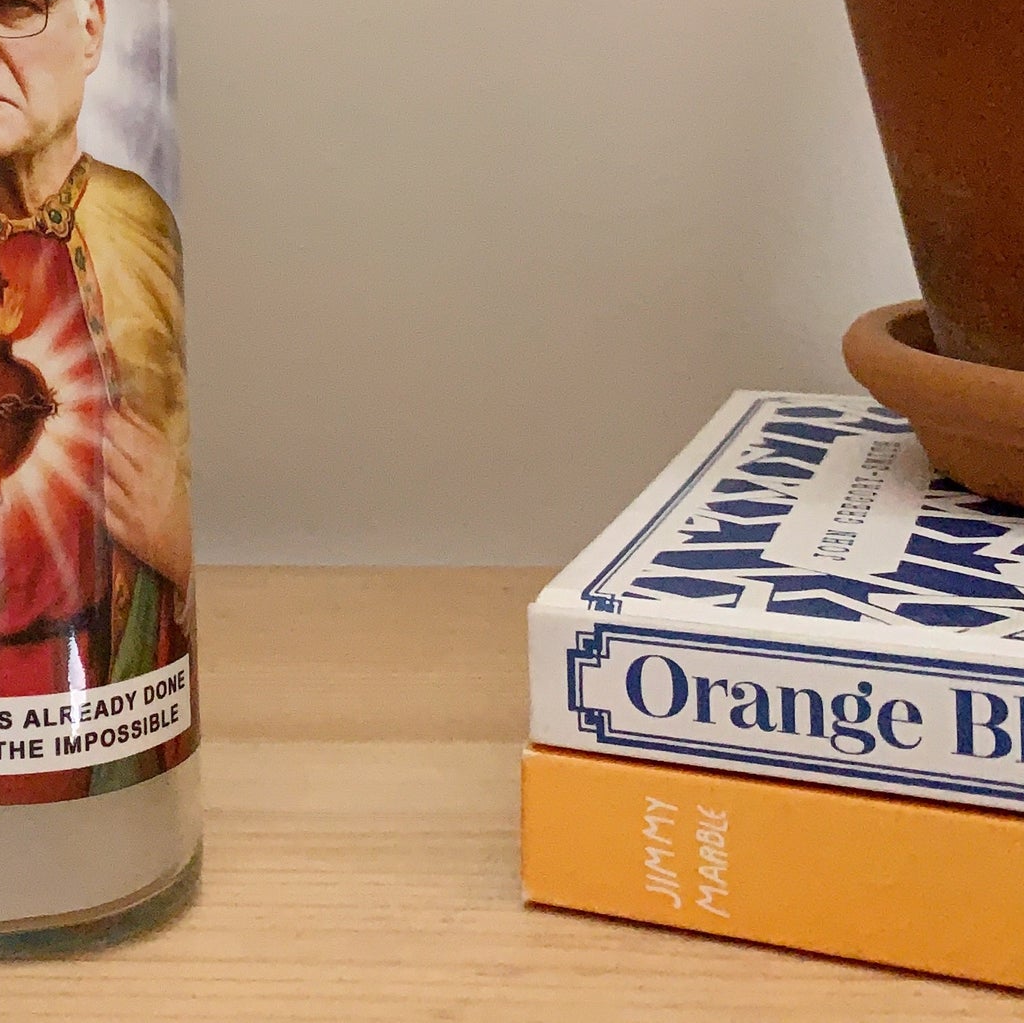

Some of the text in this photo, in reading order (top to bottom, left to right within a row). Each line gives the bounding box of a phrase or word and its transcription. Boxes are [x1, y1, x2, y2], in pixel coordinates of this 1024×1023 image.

[812, 529, 858, 561] JOHN
[23, 690, 137, 728] ALREADY
[143, 669, 185, 704] DONE
[55, 703, 179, 756] IMPOSSIBLE
[625, 654, 923, 755] Orange
[641, 795, 682, 909] JIMMY
[695, 804, 731, 919] MARBLE
